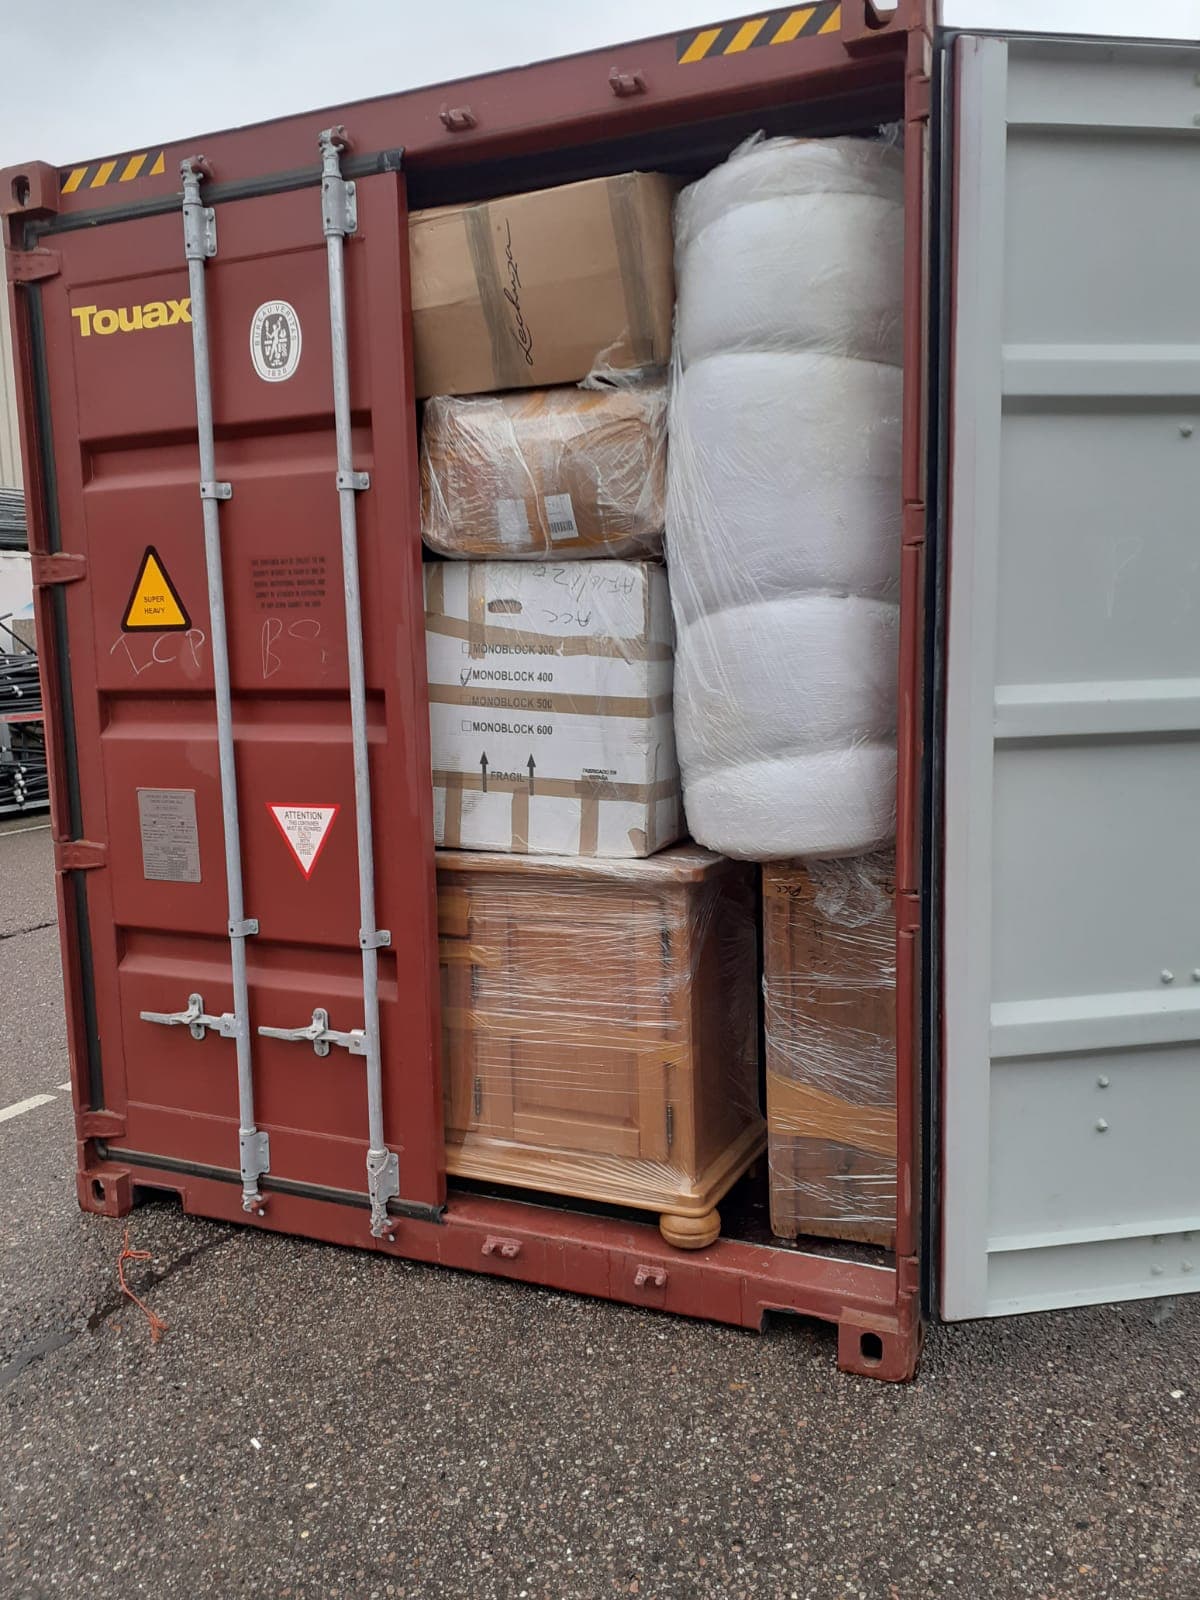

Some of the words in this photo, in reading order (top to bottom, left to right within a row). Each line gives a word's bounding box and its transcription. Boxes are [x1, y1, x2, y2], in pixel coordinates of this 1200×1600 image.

[71, 298, 192, 337] Touax
[143, 595, 165, 603] SUPER
[143, 607, 166, 615] HEAVY
[472, 643, 534, 656] MONOBLOCK
[538, 645, 554, 656] 300
[472, 669, 535, 682] MONOBLOCK
[537, 672, 553, 683] 400
[472, 695, 534, 709] MONOBLOCK
[472, 722, 535, 735] MONOBLOCK
[537, 724, 553, 735] 600
[490, 771, 525, 783] FRAGIL
[284, 811, 322, 820] ATTENTION
